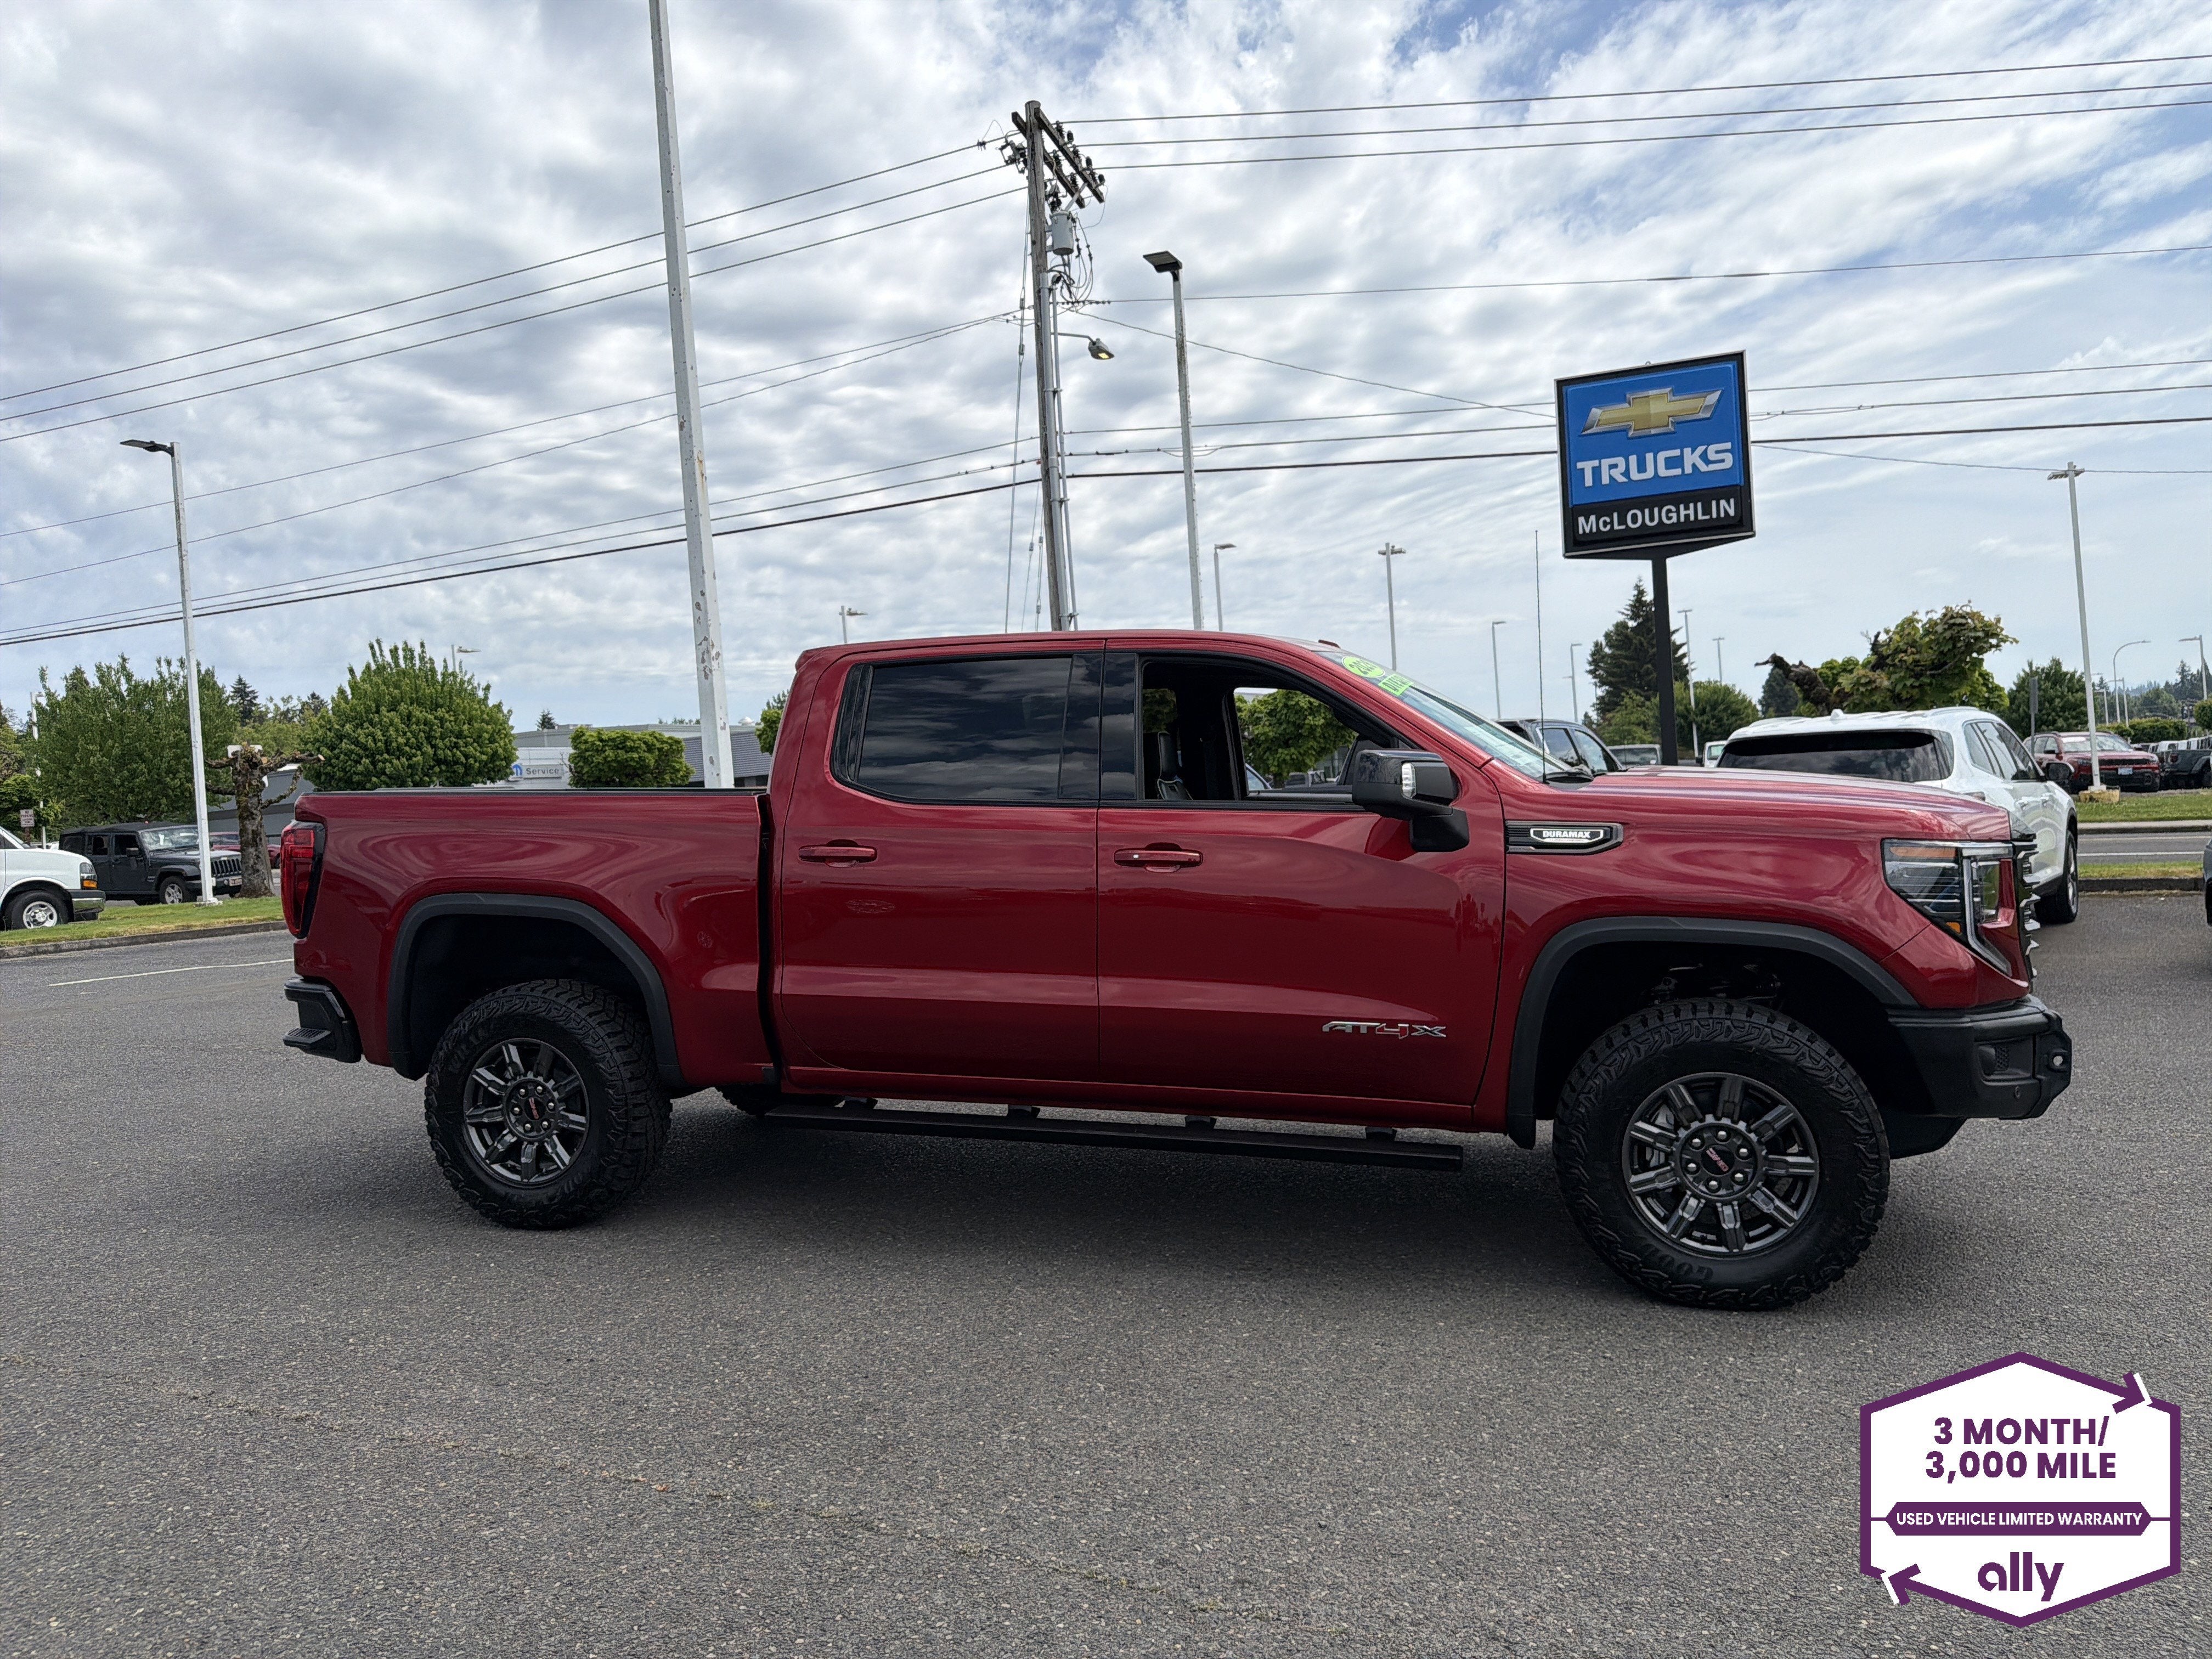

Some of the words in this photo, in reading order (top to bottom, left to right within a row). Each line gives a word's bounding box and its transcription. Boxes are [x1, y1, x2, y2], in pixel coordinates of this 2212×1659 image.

[1577, 442, 1733, 487] TRUCKS
[1578, 498, 1735, 535] McLOUGHLIN
[1322, 1021, 1447, 1039] AT4X
